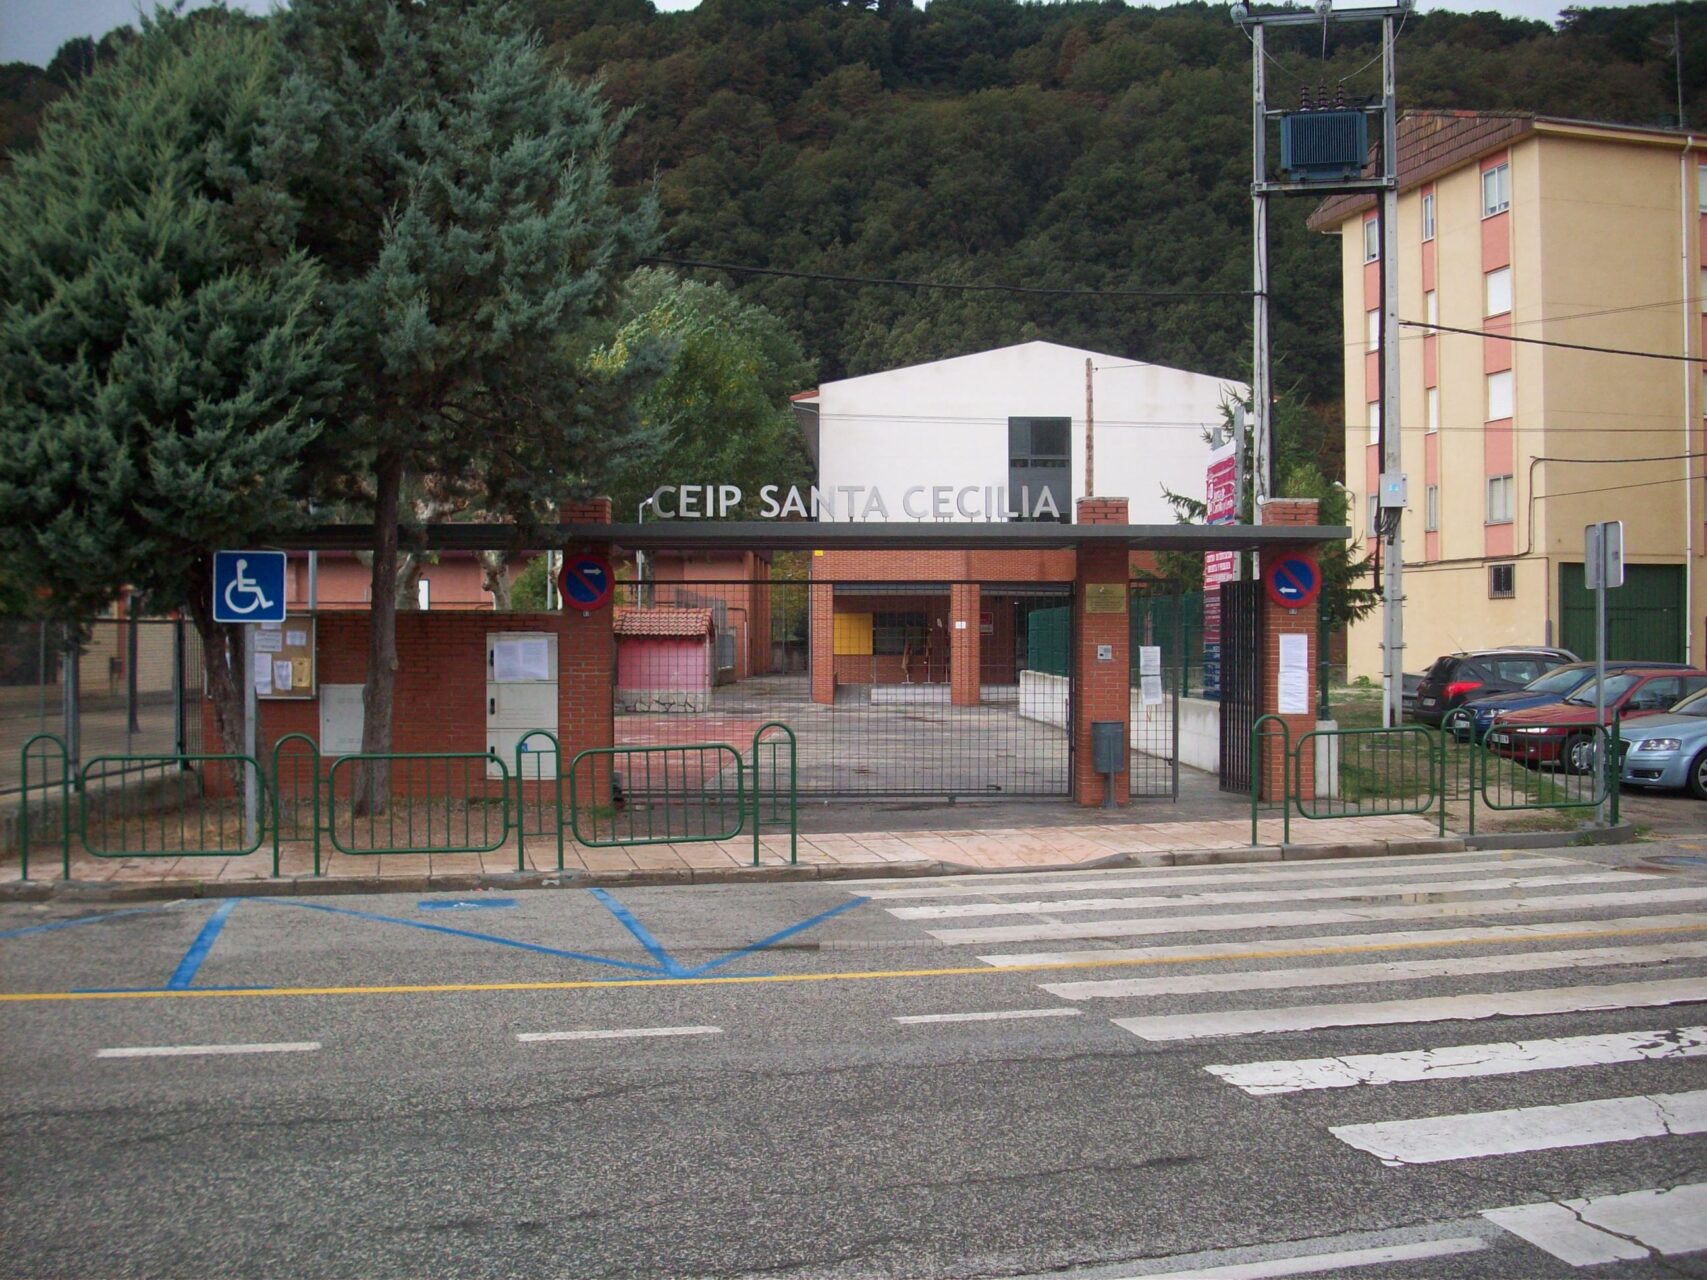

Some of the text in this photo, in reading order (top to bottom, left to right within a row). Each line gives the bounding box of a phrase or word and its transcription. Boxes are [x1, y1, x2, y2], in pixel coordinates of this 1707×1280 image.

[652, 485, 1060, 518] CEIP SANTA CECILIA
